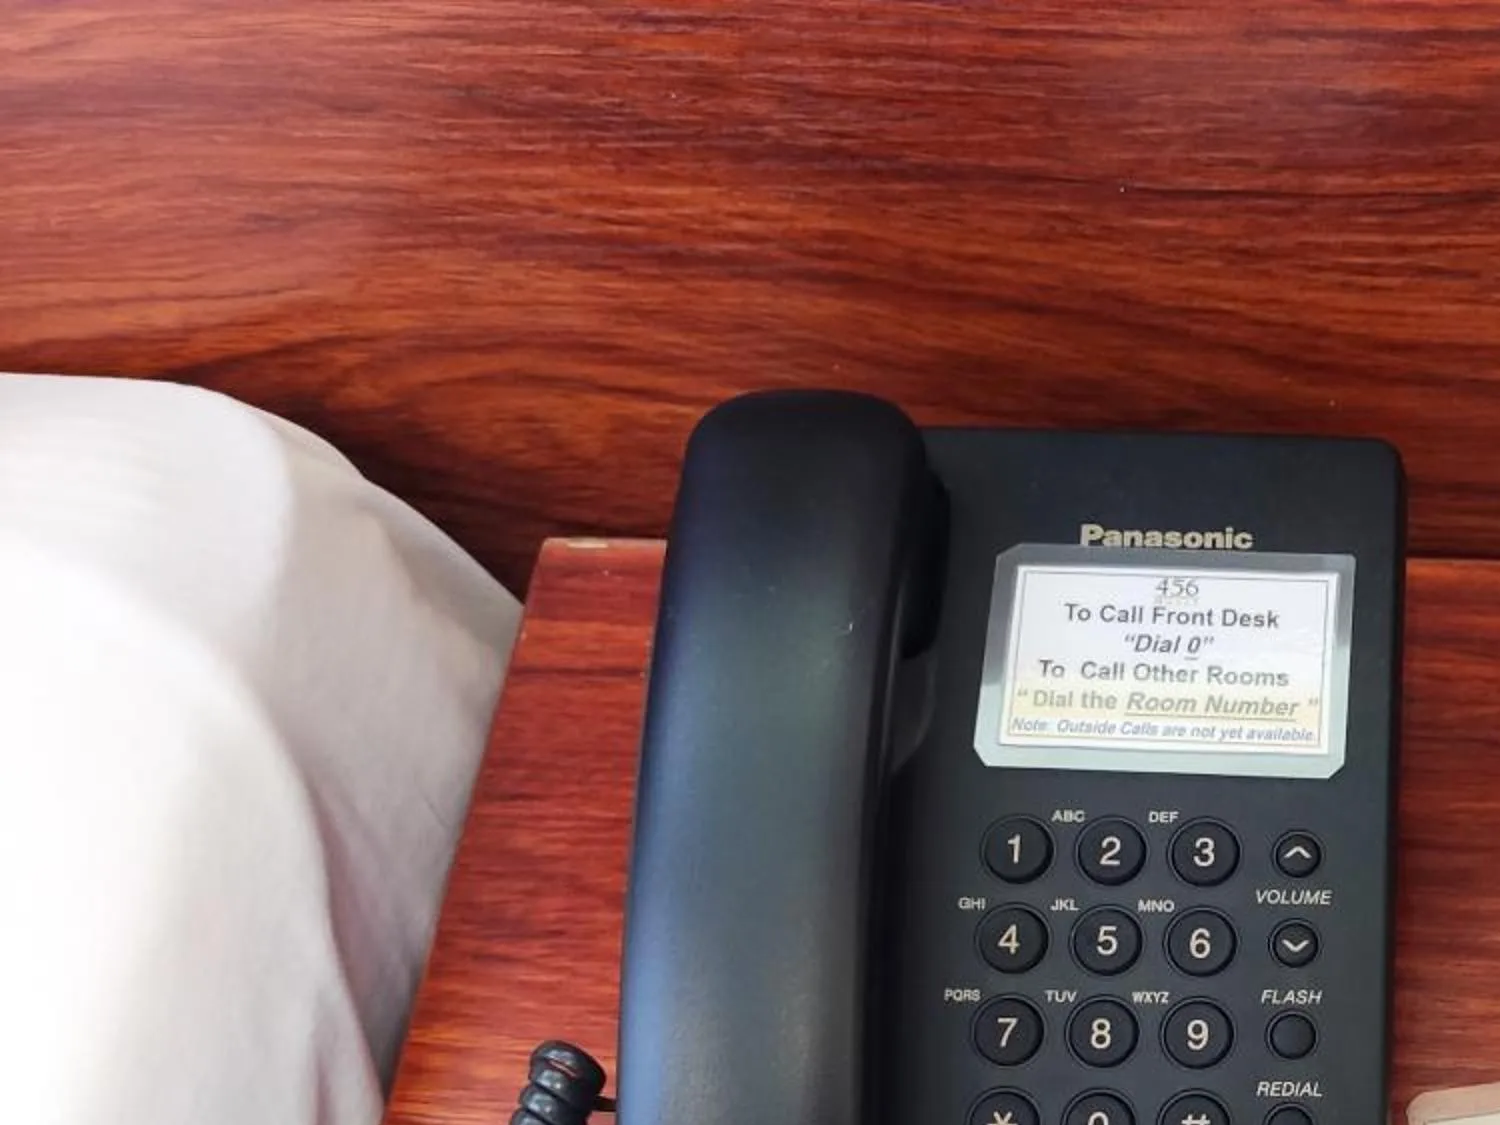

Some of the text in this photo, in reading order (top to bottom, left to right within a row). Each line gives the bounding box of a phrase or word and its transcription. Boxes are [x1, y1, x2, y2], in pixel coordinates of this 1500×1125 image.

[1080, 523, 1253, 550] Panasonic
[1156, 577, 1199, 598] 456
[1065, 603, 1279, 628] To Call Front Desk
[1039, 660, 1289, 687] To Call Other Rooms
[1082, 692, 1117, 710] the
[1127, 692, 1197, 713] Room
[1205, 695, 1298, 717] Number
[1057, 720, 1118, 735] Outside
[1121, 721, 1158, 736] Calls
[1162, 726, 1187, 738] are
[1190, 726, 1216, 739] not
[1220, 726, 1243, 742] yet
[1052, 809, 1086, 823] ABC
[1149, 811, 1179, 823] DEF
[1008, 834, 1021, 863] 1
[1100, 836, 1122, 866] 2
[1193, 837, 1215, 867] 3
[958, 898, 986, 910] GHI
[1050, 899, 1079, 912] JKL
[1138, 900, 1176, 913] MNO
[1256, 890, 1333, 905] VOLUME
[998, 924, 1019, 955] 4
[1097, 925, 1118, 956] 5
[1189, 929, 1212, 959] 6
[944, 989, 980, 1002] PQRS
[1045, 990, 1077, 1003] TUV
[1132, 992, 1169, 1004] WXYZ
[1260, 990, 1322, 1004] FLASH
[997, 1017, 1018, 1048] 7
[1090, 1018, 1112, 1049] 8
[1186, 1019, 1209, 1050] 9
[1256, 1081, 1322, 1097] REDIAL
